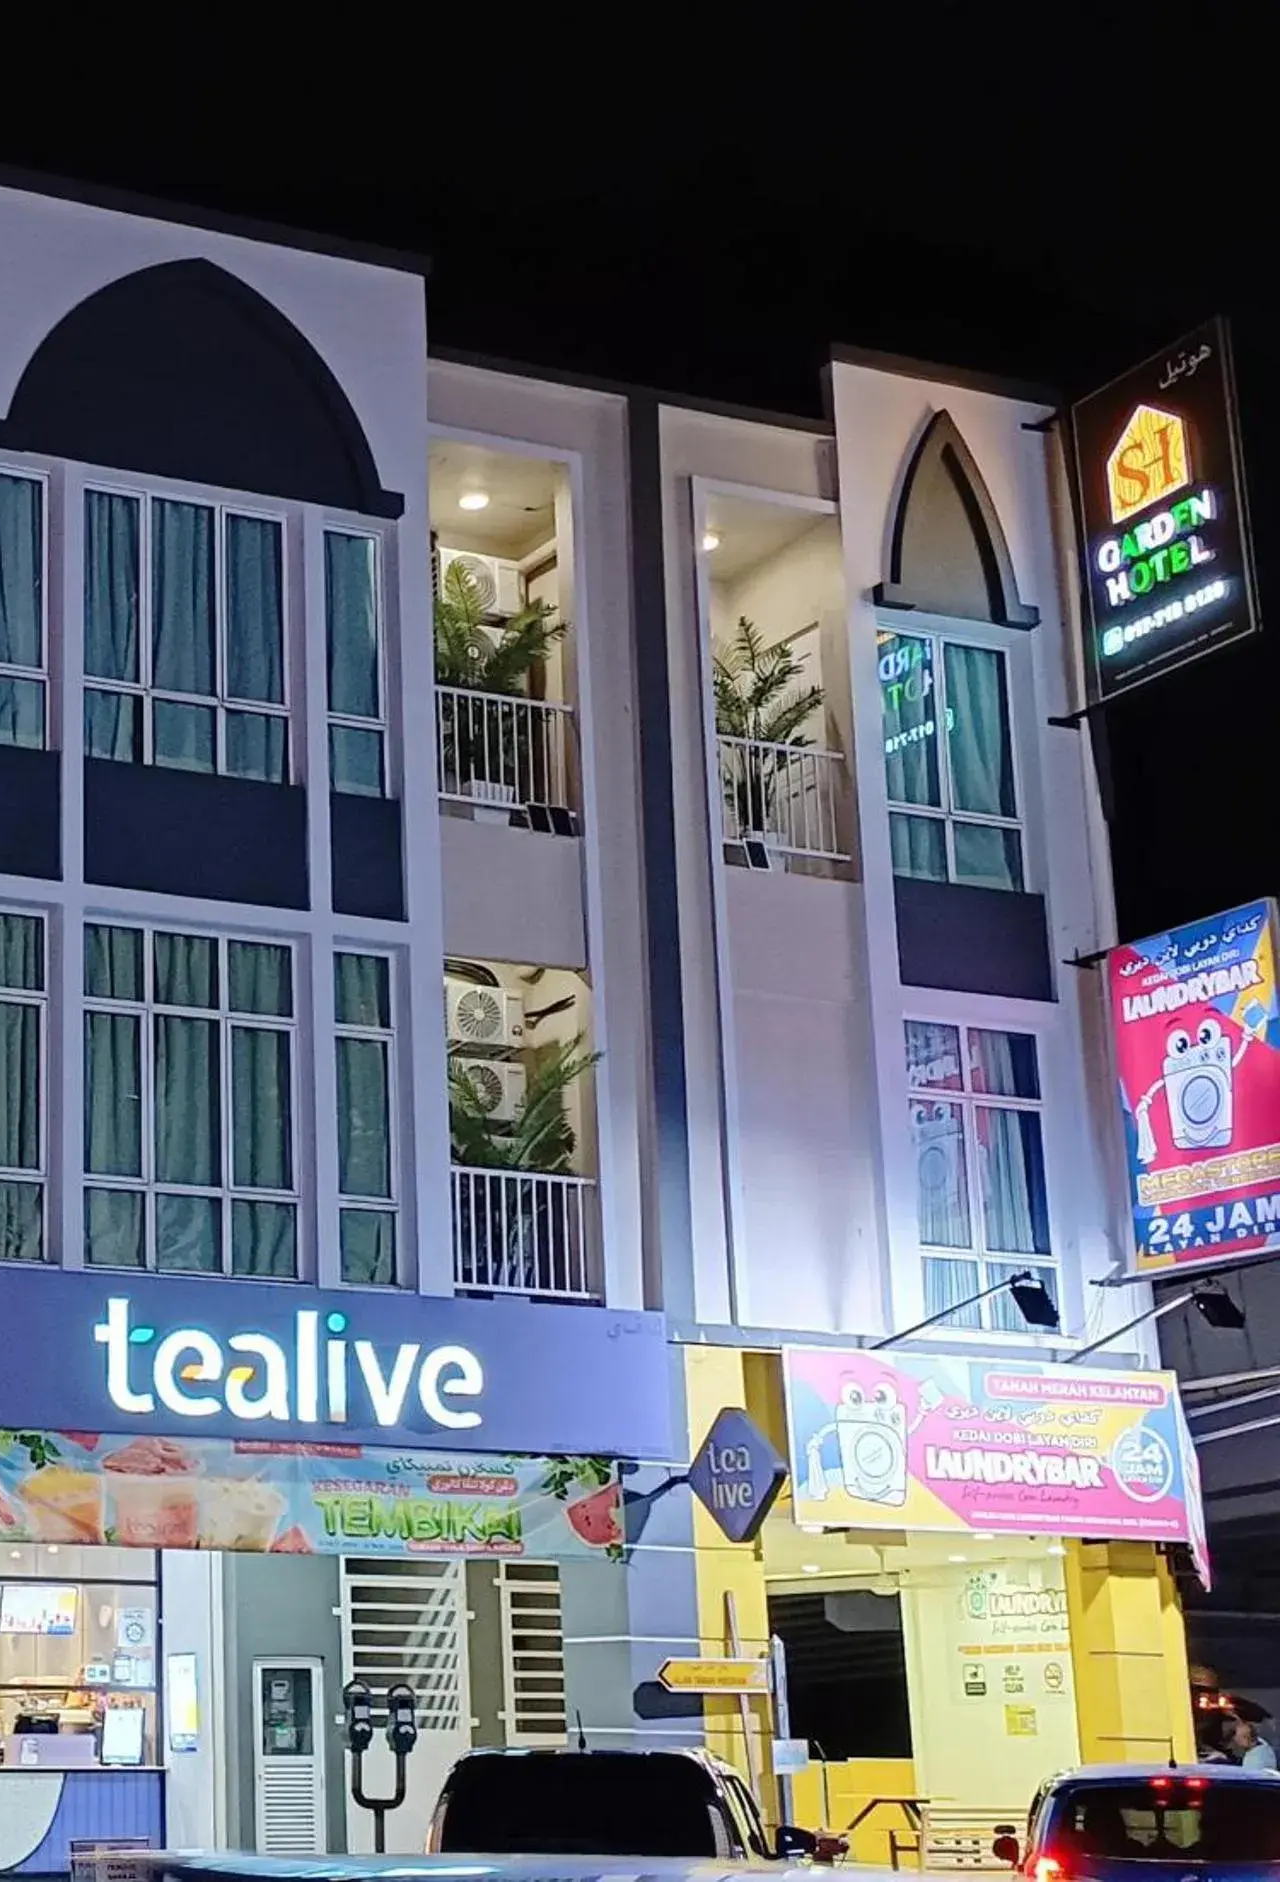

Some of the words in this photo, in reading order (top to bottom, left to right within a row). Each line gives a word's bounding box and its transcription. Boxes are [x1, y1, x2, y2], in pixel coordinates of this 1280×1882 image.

[1098, 489, 1217, 573] GARDEN
[1106, 535, 1216, 607] HOTEL
[1122, 959, 1265, 1024] LAUNDRYBAR
[1148, 1213, 1195, 1245] 24
[1205, 1193, 1280, 1233] JAM
[1149, 1232, 1222, 1256] LAYAN
[94, 1298, 483, 1430] tealive
[992, 1378, 1040, 1396] TANAH
[1041, 1381, 1087, 1399] MERAH
[1088, 1384, 1160, 1403] KELANTAN
[707, 1442, 751, 1473] tea
[953, 1429, 993, 1443] KEDAI
[1028, 1433, 1067, 1448] LAYAN
[1121, 1440, 1164, 1463] 24
[924, 1443, 1106, 1490] LAUNDRYBAR
[1124, 1463, 1163, 1477] JAM
[711, 1477, 753, 1509] live
[314, 1497, 524, 1543] TEMBIKAI
